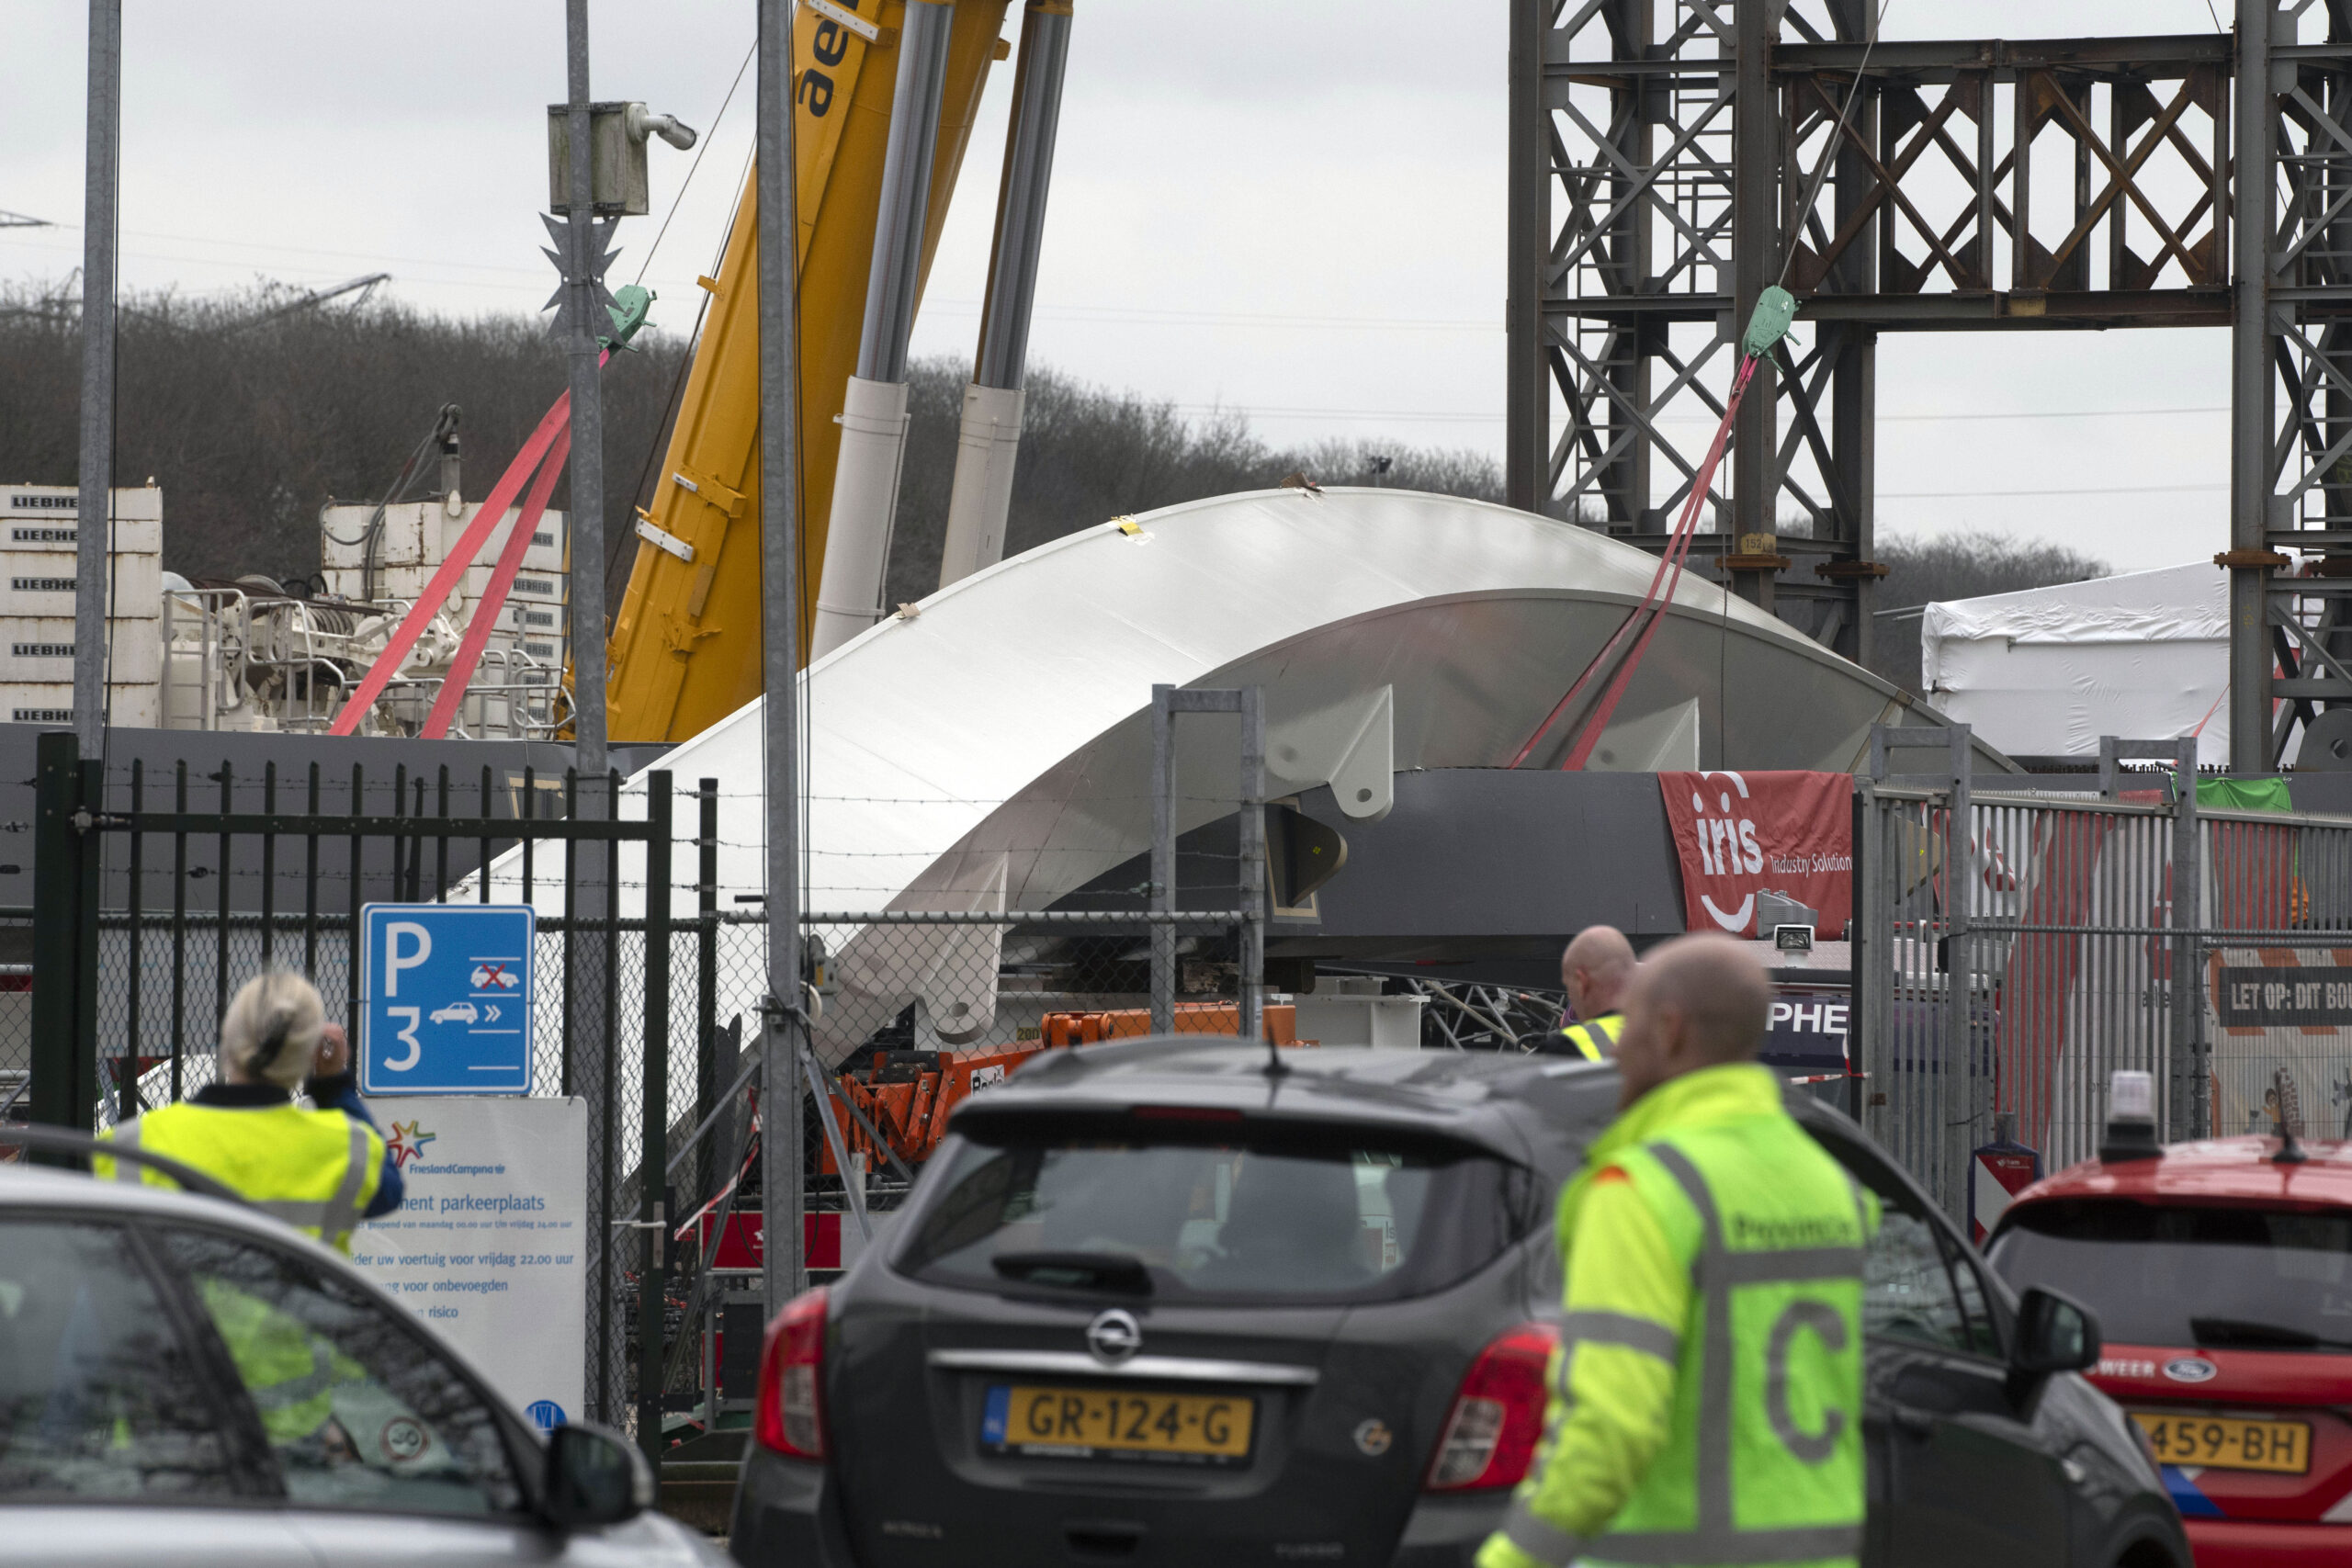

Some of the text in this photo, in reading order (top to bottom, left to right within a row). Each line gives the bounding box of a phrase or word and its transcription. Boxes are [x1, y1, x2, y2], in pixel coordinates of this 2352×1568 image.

[797, 0, 860, 118] ae
[13, 497, 78, 508] LIEBHE
[13, 530, 78, 541] LIEBHE
[13, 579, 77, 590] LIEBHE
[13, 645, 75, 656] LIEBH
[14, 710, 74, 721] LIEBH
[1693, 792, 1852, 878] iris Industry Solution
[385, 921, 432, 998] P
[2231, 983, 2261, 1010] LET
[2265, 983, 2291, 1010] OP:
[2296, 983, 2321, 1010] DIT
[1765, 1002, 1849, 1034] PHE
[383, 1007, 422, 1072] 3
[440, 1193, 546, 1214] parkeerplaats
[419, 1220, 454, 1230] maandag
[377, 1256, 395, 1266] uw
[399, 1252, 447, 1268] voertuig
[449, 1255, 476, 1266] voor
[478, 1252, 516, 1268] vrijdag
[520, 1255, 552, 1265] 22.00
[555, 1255, 574, 1265] uur
[402, 1281, 429, 1292] voor
[433, 1279, 508, 1294] onbevoegden
[428, 1305, 458, 1318] risico
[2087, 1359, 2156, 1377] WEER
[1764, 1299, 1847, 1465] C
[1027, 1393, 1230, 1446] GR-124-G
